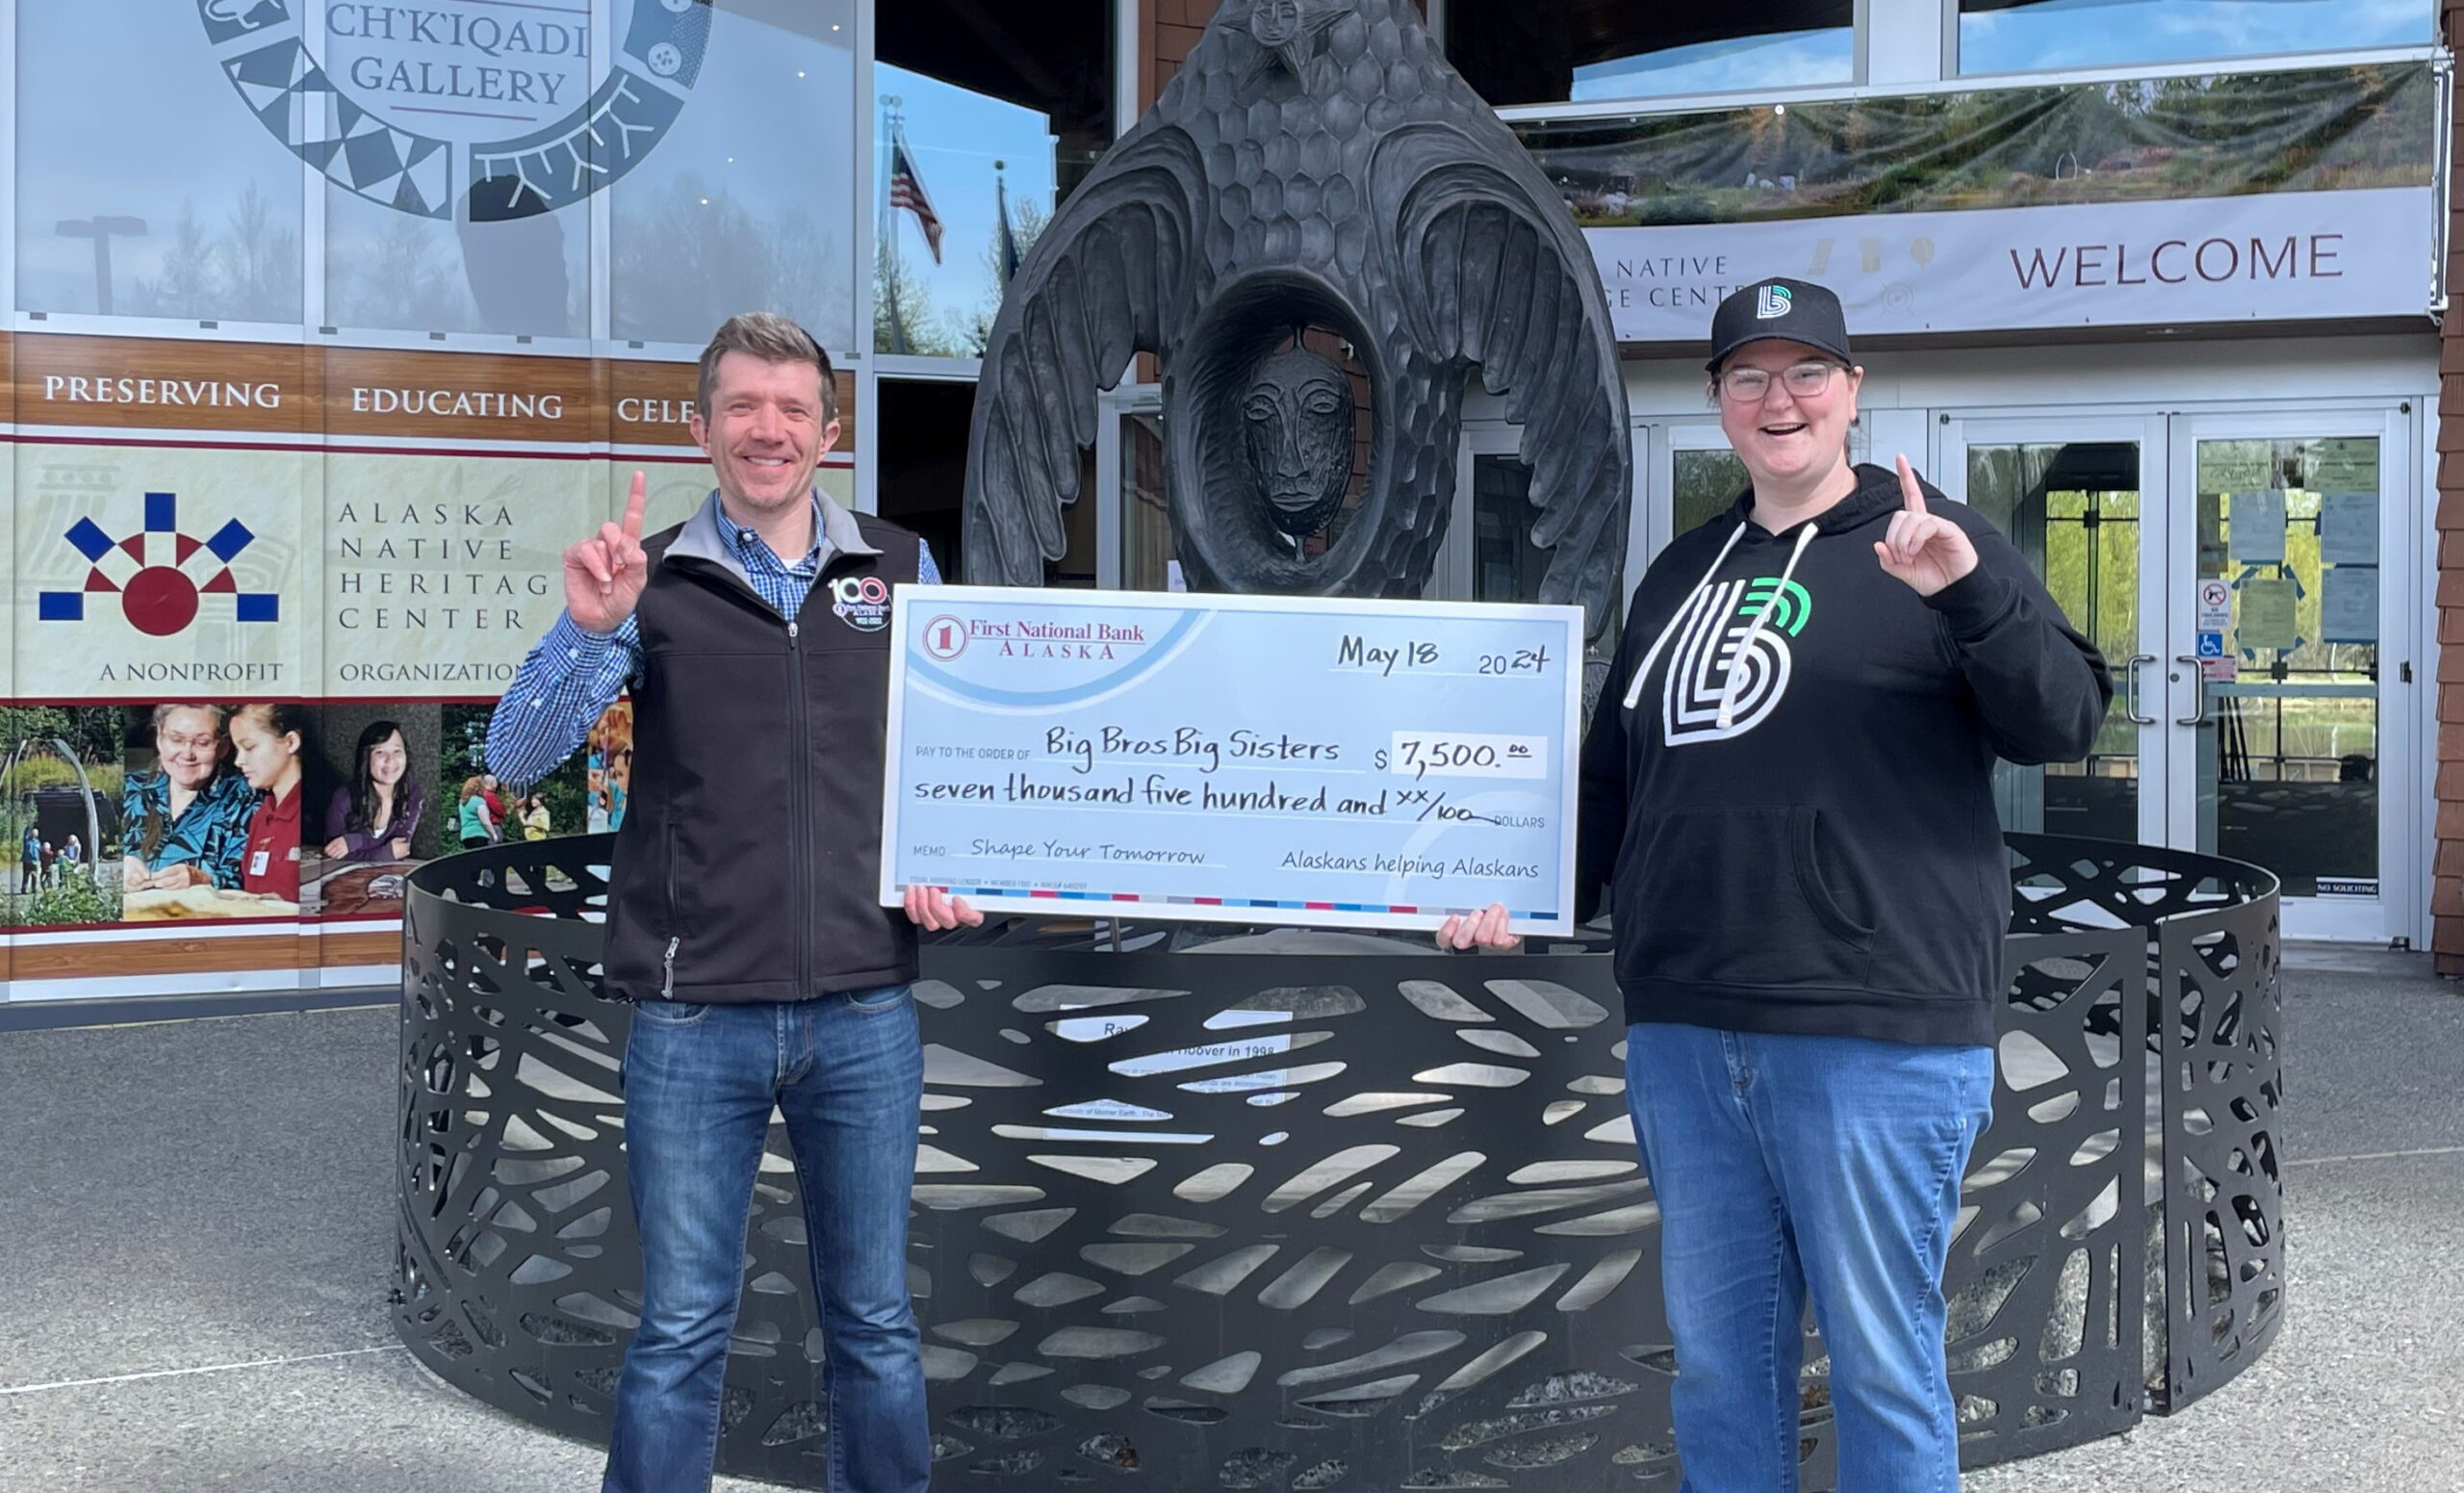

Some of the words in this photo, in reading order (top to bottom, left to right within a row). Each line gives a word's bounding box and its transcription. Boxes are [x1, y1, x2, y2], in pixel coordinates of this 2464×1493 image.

[350, 56, 566, 105] GALLERY
[1617, 255, 1728, 278] NATIVE
[2010, 233, 2344, 289] WELCOME
[1649, 284, 1745, 307] CENT
[43, 375, 281, 408] PRESERVING
[352, 387, 564, 420] EDUCATING
[338, 502, 514, 526] ALASKA
[340, 537, 513, 560] NATIVE
[340, 573, 549, 596] HERITAG
[338, 607, 525, 630] CENTER
[969, 619, 1011, 637] First
[1016, 621, 1092, 640] National
[1097, 623, 1145, 642] Bank
[999, 639, 1116, 660] ALASKA
[1338, 634, 1399, 677] May
[1407, 641, 1439, 666] 18
[99, 663, 116, 681] A
[127, 662, 284, 682] NONPROFIT
[916, 745, 936, 757] PAY
[939, 746, 953, 758] TO
[956, 747, 975, 759] THE
[978, 748, 1014, 759] ORDER
[1017, 750, 1031, 760] OF
[1045, 725, 1093, 773] Big
[1100, 725, 1168, 755] Bros
[1174, 726, 1219, 773] Big
[1229, 729, 1341, 760] Sisters
[914, 782, 994, 801] seven
[1003, 772, 1134, 805] thousand
[1141, 774, 1193, 806] five
[1203, 780, 1326, 811] hundred
[1337, 789, 1387, 815] and
[1494, 814, 1545, 828] DOLLARS
[913, 845, 945, 857] MEMO
[971, 838, 1037, 860] Shape
[1043, 838, 1091, 860] Your
[1099, 844, 1205, 864] Tomorrow
[1281, 850, 1367, 871] Alaskans
[1374, 853, 1445, 880] helping
[1451, 858, 1540, 879] Alaskans
[2317, 884, 2330, 892] NO
[2332, 885, 2377, 893] SOLICITING
